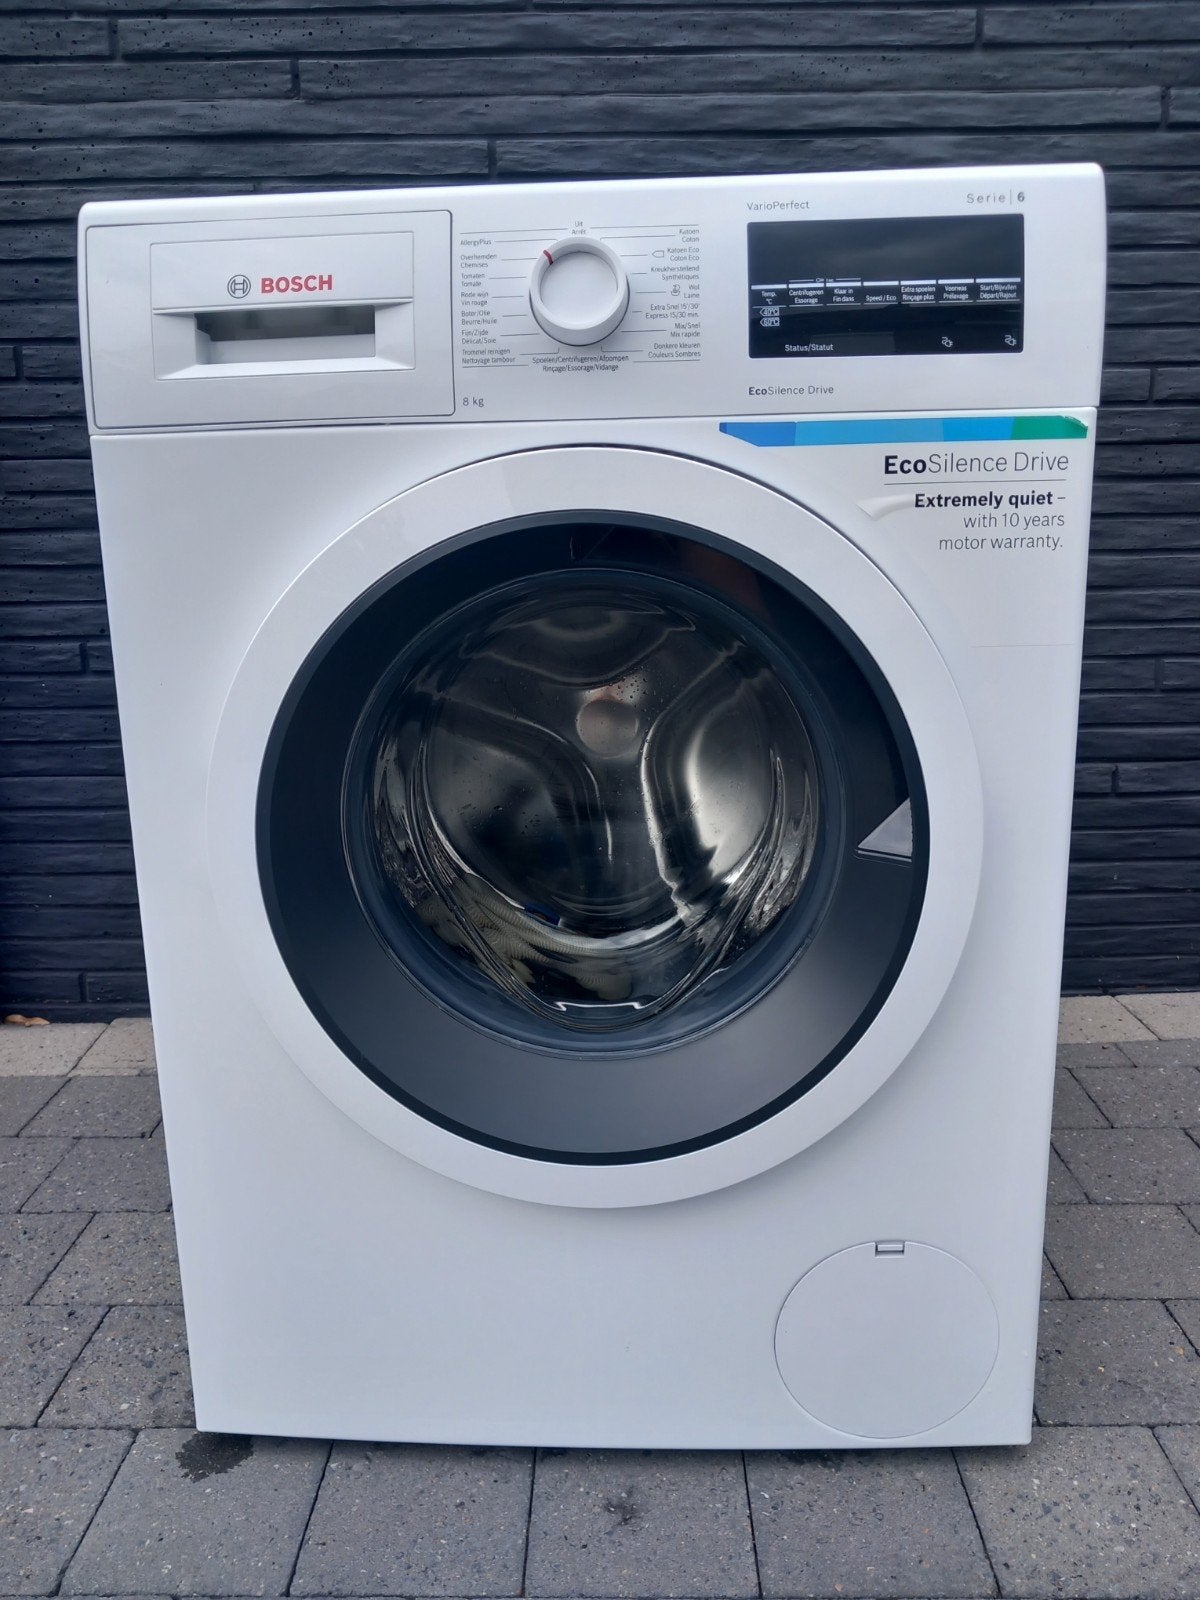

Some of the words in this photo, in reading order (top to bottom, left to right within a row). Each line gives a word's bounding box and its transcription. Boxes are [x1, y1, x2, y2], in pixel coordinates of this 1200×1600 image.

[966, 192, 1006, 203] Serie
[1017, 192, 1025, 202] 6
[747, 200, 809, 211] VarioPerfect
[261, 274, 332, 294] BOSCH
[789, 289, 824, 297] Centrifugeren
[917, 286, 935, 294] spoelen
[924, 293, 934, 301] plus
[654, 342, 677, 350] Donkere
[785, 343, 834, 352] Status/Statut
[748, 386, 805, 395] EcoSilence
[808, 385, 834, 394] Drive
[462, 397, 469, 406] 8
[472, 396, 484, 407] kg
[884, 452, 1008, 475] EcoSilence
[1014, 451, 1069, 472] Drive
[914, 491, 1004, 510] Extremely
[1008, 490, 1054, 508] quiet
[963, 514, 998, 529] with
[1001, 513, 1020, 528] 10
[1023, 513, 1065, 530] years
[939, 536, 987, 552] motor
[991, 535, 1064, 552] warranty.
